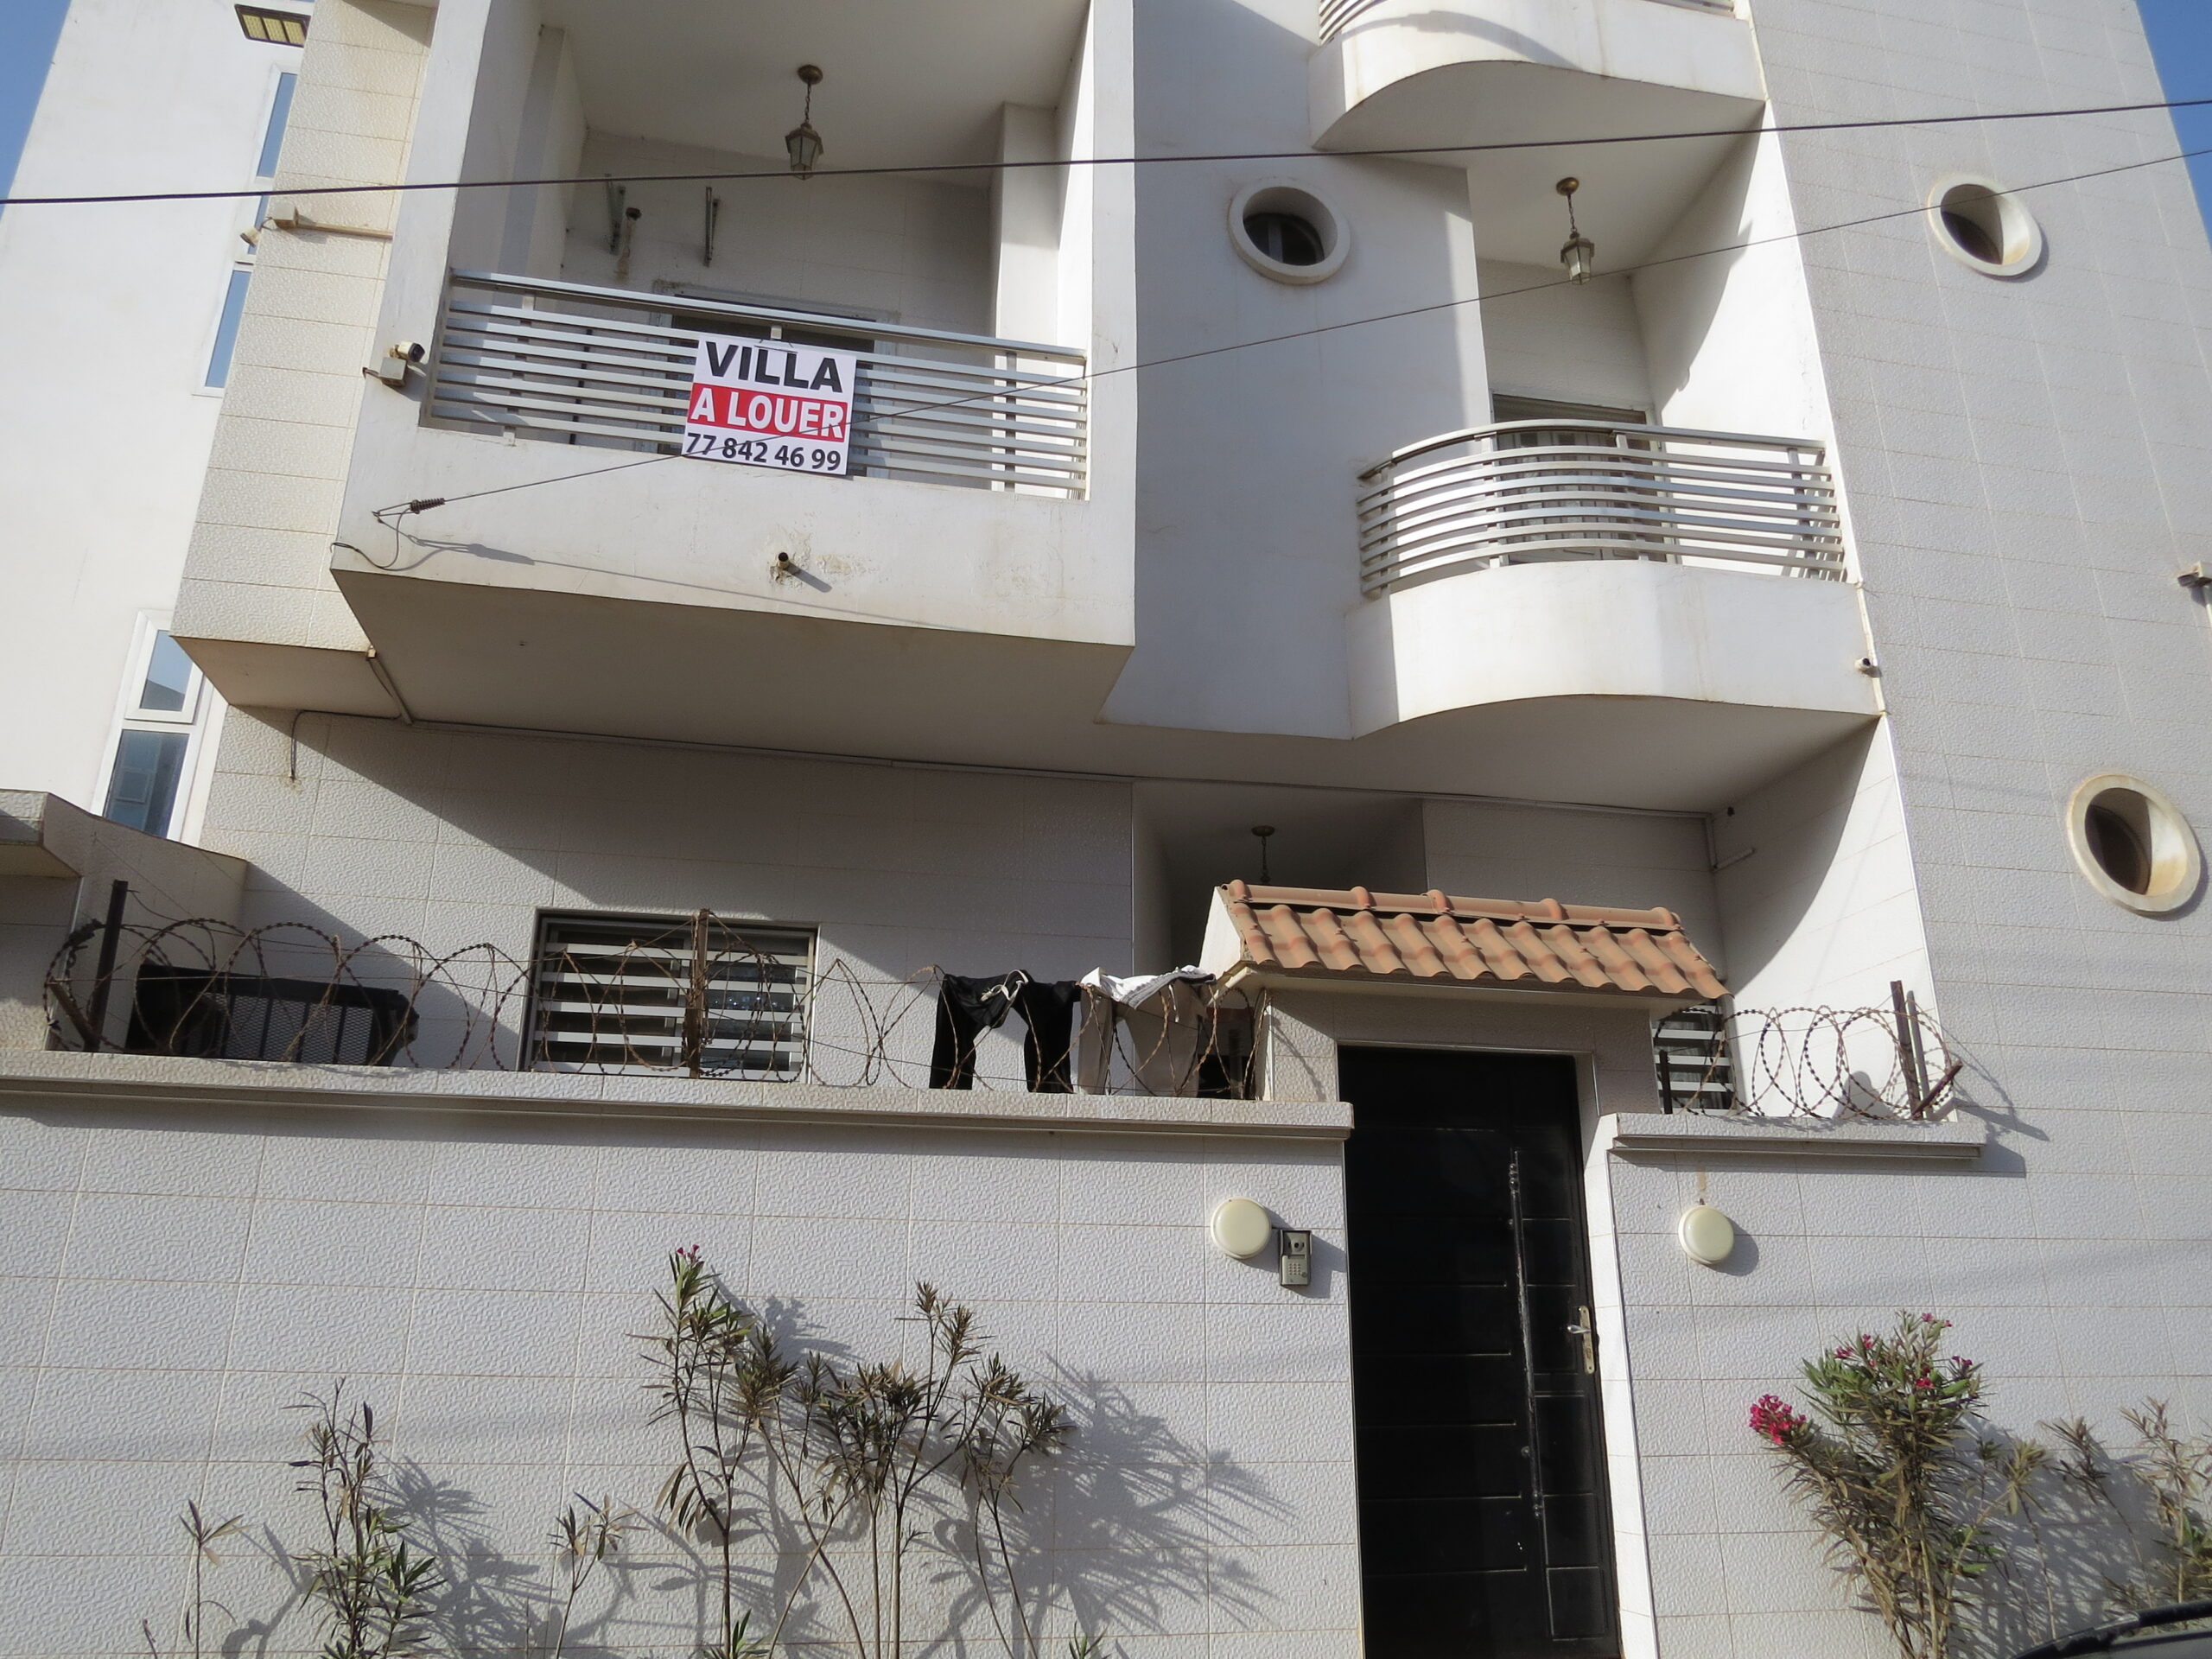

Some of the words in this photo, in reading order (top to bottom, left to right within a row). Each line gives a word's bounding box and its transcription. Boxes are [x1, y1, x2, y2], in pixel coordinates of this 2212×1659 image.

[705, 341, 843, 393] VILLA
[690, 387, 715, 423] A
[727, 391, 843, 439] LOUER
[686, 432, 717, 455] 77
[721, 437, 768, 463] 842
[774, 445, 804, 467] 46
[811, 448, 841, 471] 99
